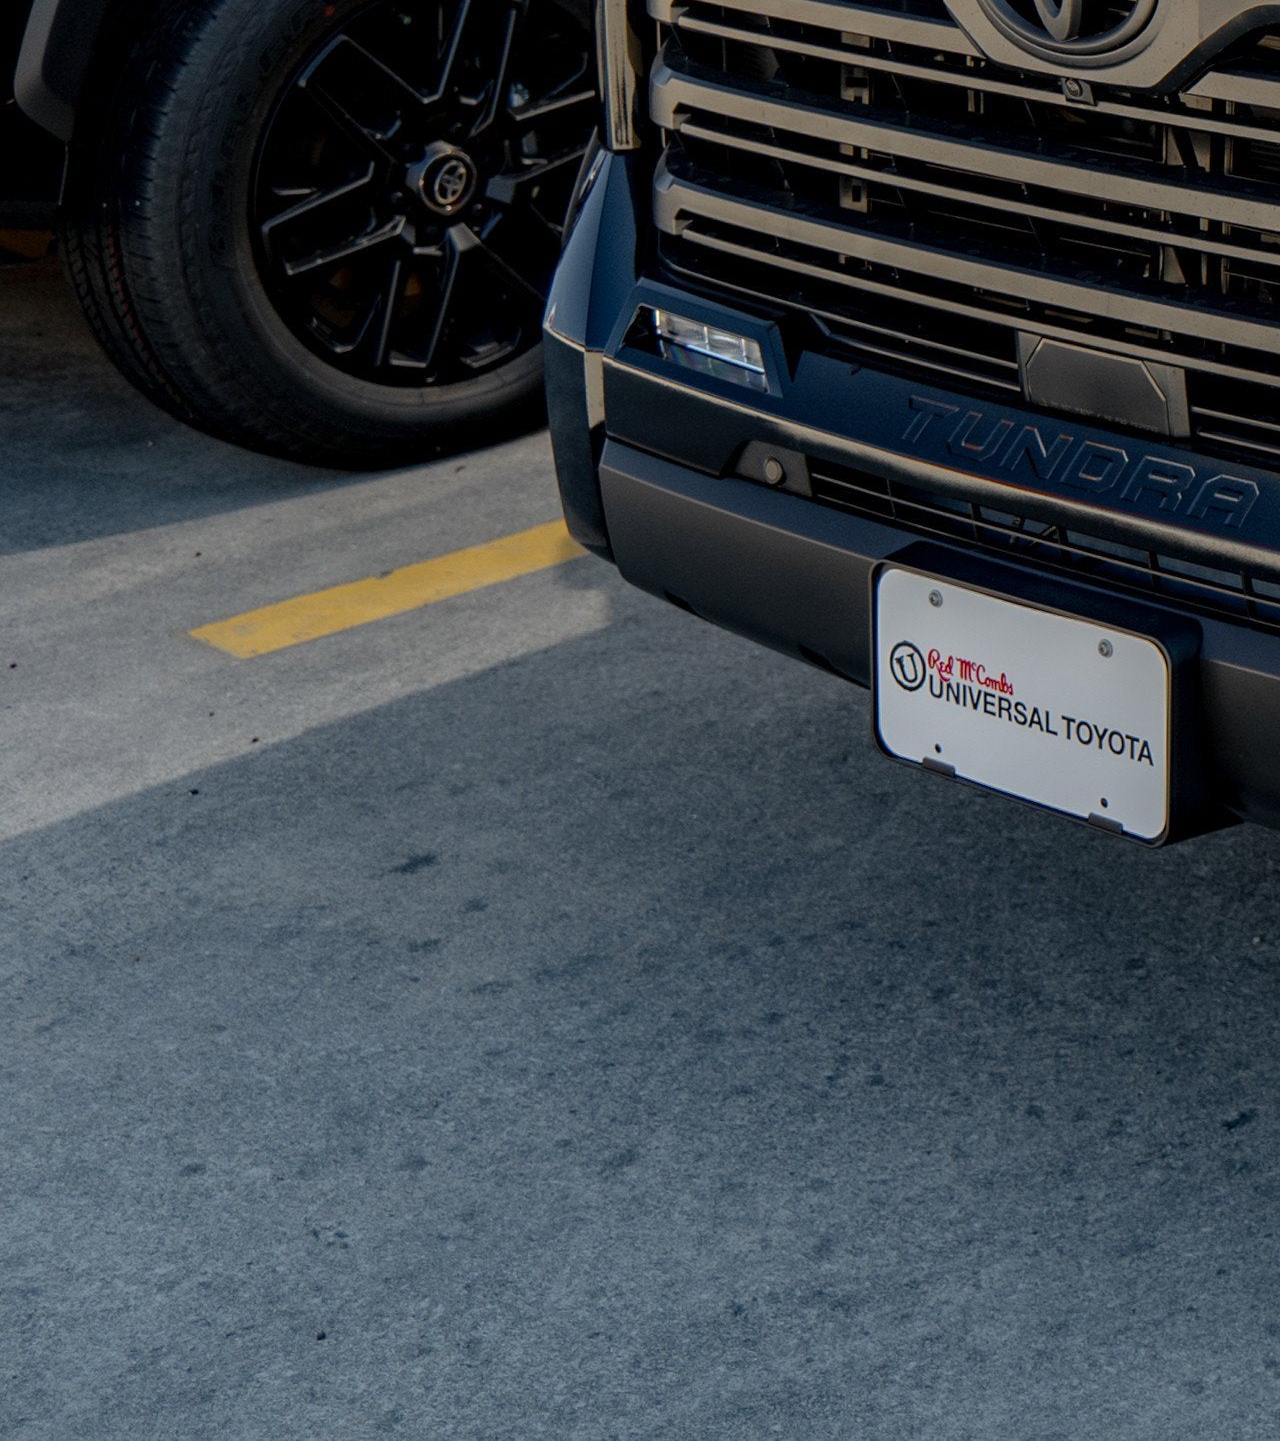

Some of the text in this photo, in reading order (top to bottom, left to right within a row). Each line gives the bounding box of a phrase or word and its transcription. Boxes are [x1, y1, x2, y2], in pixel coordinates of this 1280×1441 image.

[901, 394, 1261, 528] TUNDRA
[927, 648, 1014, 696] Red McCombs
[928, 673, 1154, 767] UNIVERSAL TOYOTA
